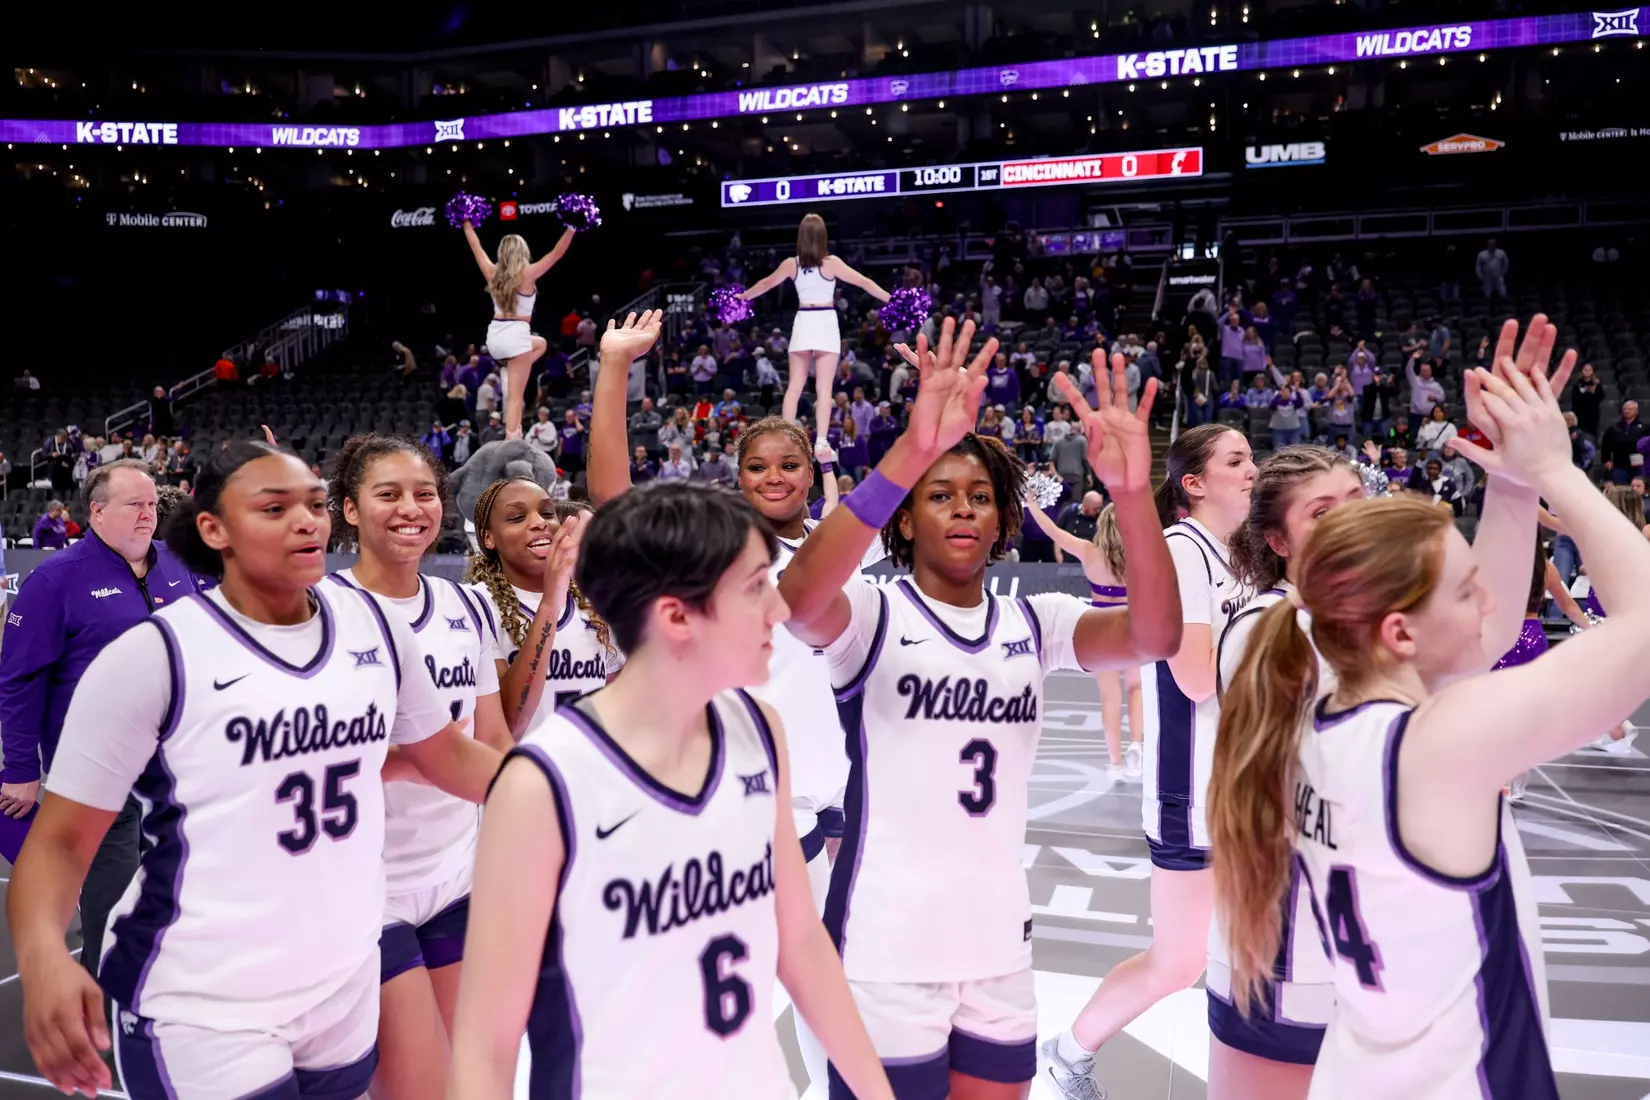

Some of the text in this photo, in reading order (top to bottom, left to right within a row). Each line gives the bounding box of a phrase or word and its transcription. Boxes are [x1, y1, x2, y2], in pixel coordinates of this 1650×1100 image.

[1356, 26, 1472, 57] WILDCATS
[1117, 45, 1238, 80] K-STATE
[739, 83, 849, 112] WILDCATS
[559, 101, 653, 130] K-STATE
[76, 122, 178, 144] K-STATE
[272, 127, 360, 146] WILDCATS
[1438, 140, 1486, 152] SERVPRO
[1246, 142, 1326, 164] UMB
[776, 180, 791, 201] 0
[818, 176, 885, 196] K-STATE
[914, 167, 961, 186] 10:00
[1004, 159, 1102, 183] CINCINNATI
[1121, 155, 1138, 177] 0
[119, 212, 160, 226] Mobile
[161, 215, 203, 227] CENTER
[897, 674, 1037, 723] Wildcats
[225, 697, 387, 767] Wildcats
[957, 738, 999, 818] 3
[274, 757, 362, 857] 35
[602, 843, 776, 941] Wildcat
[698, 932, 755, 1041] 6
